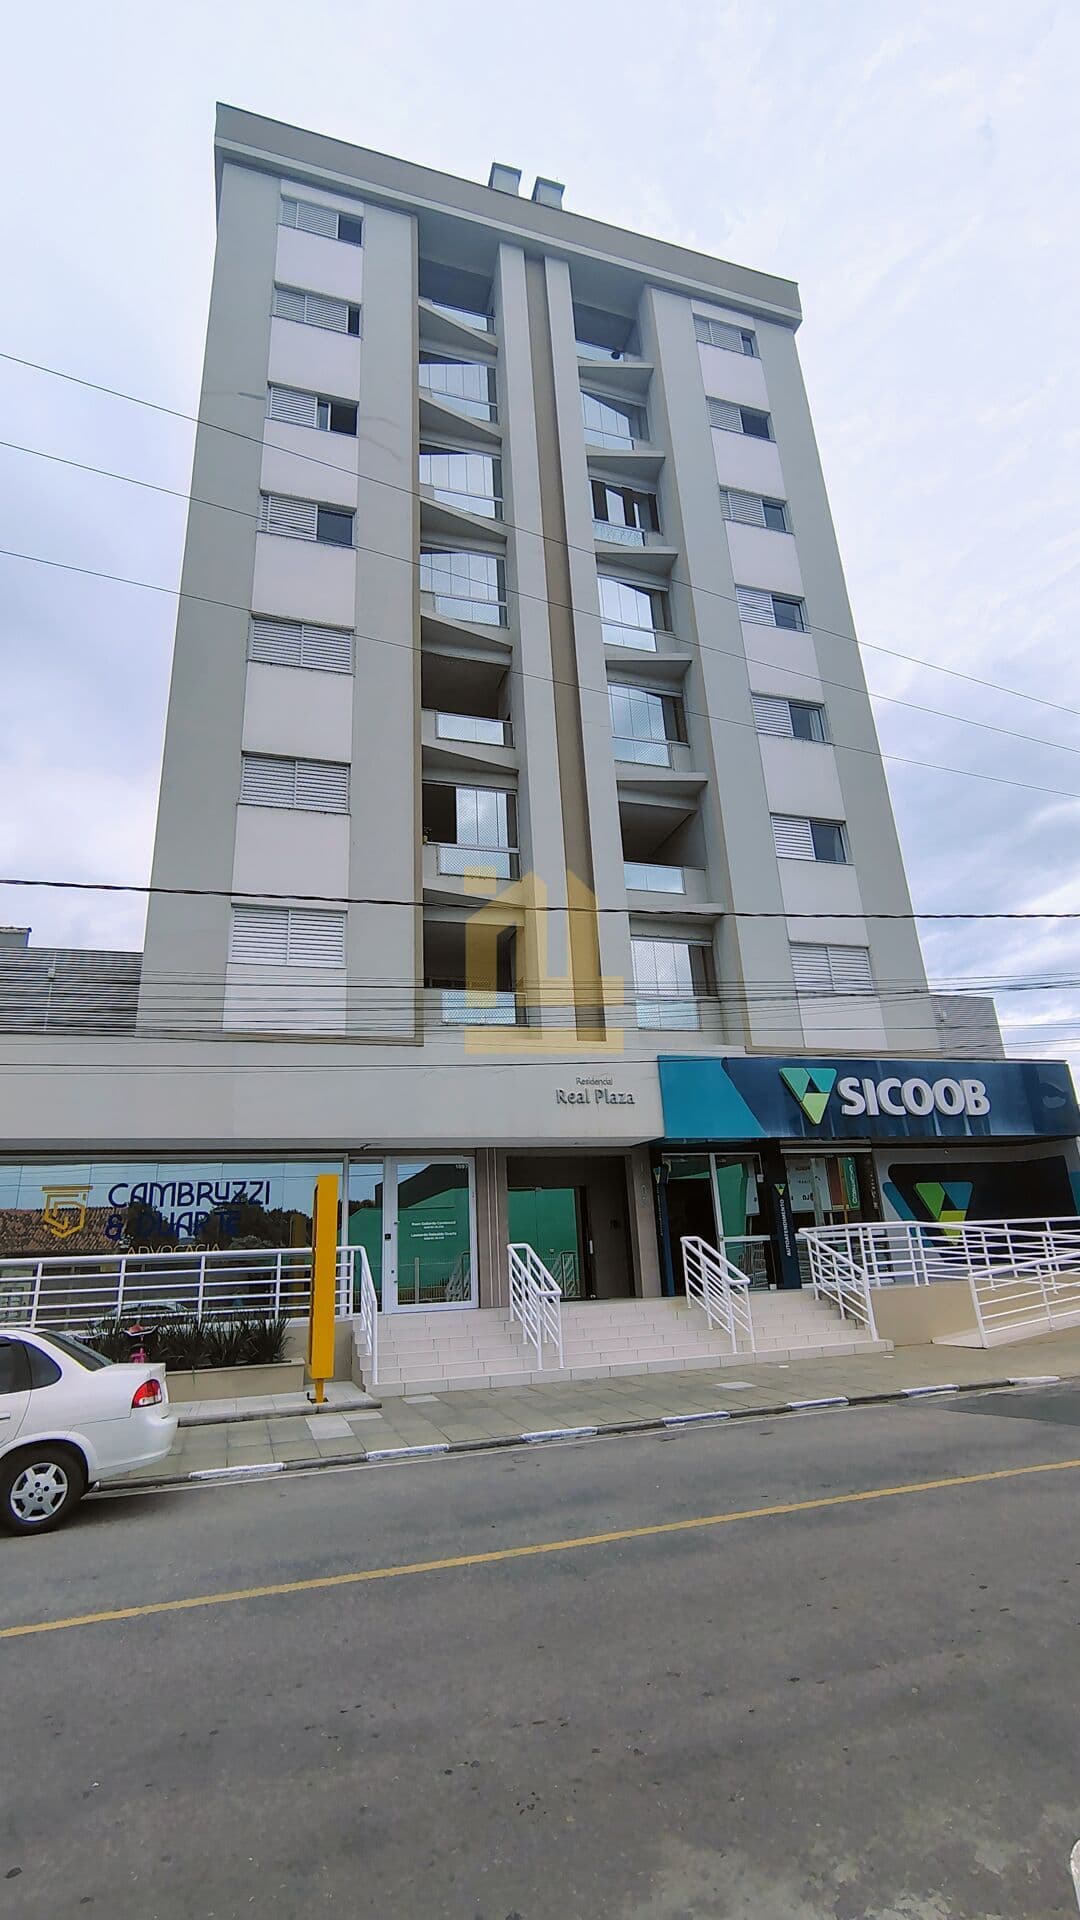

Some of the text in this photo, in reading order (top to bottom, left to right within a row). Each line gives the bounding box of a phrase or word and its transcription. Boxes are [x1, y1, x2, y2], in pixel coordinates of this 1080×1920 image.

[575, 1076, 613, 1086] Residencial
[555, 1087, 636, 1104] Real Plaza
[837, 1077, 991, 1116] SICOOB
[108, 1181, 271, 1208] CAMBRUZZI
[105, 1214, 125, 1242] &
[779, 1198, 792, 1257] AUTOATENDIMENTO
